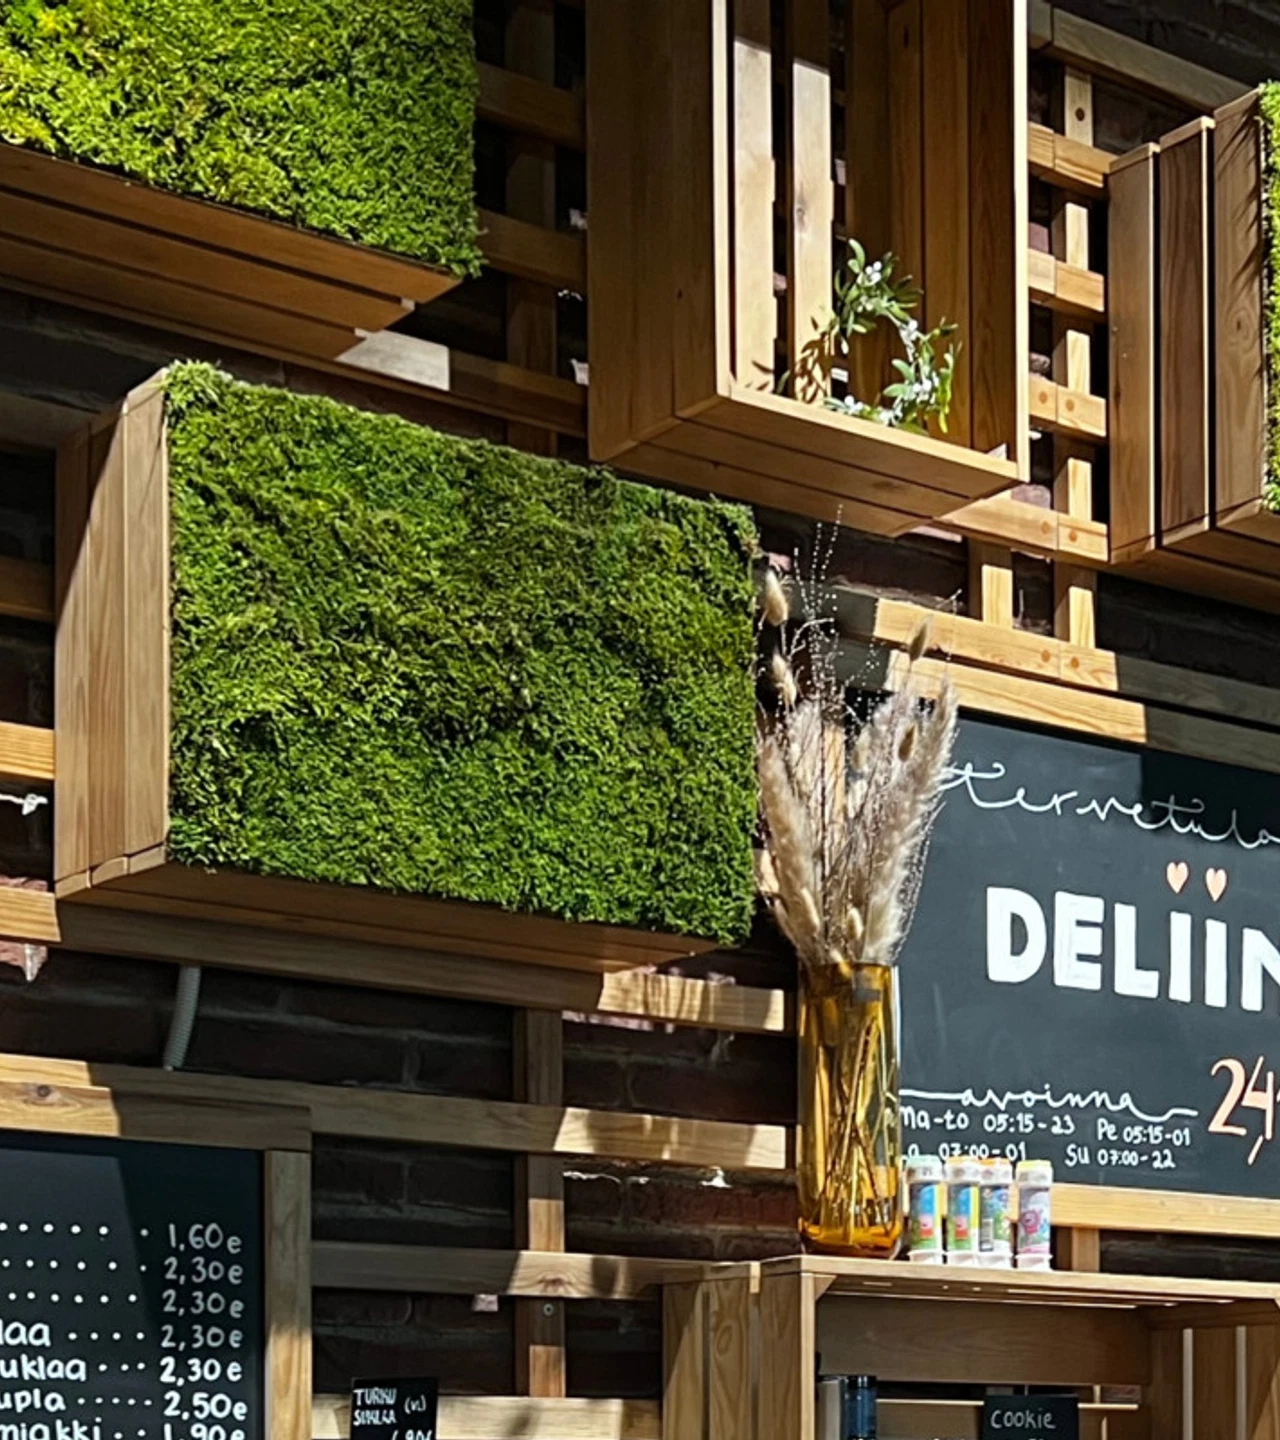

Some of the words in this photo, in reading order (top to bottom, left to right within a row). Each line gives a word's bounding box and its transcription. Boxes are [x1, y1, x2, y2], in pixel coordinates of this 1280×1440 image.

[168, 1222, 243, 1254] 1,60e
[163, 1257, 244, 1286] 2,30e
[161, 1288, 245, 1319] 2,30e
[160, 1326, 244, 1351] 2,30e
[159, 1356, 243, 1387] 2,30e
[163, 1390, 248, 1423] 2,50e
